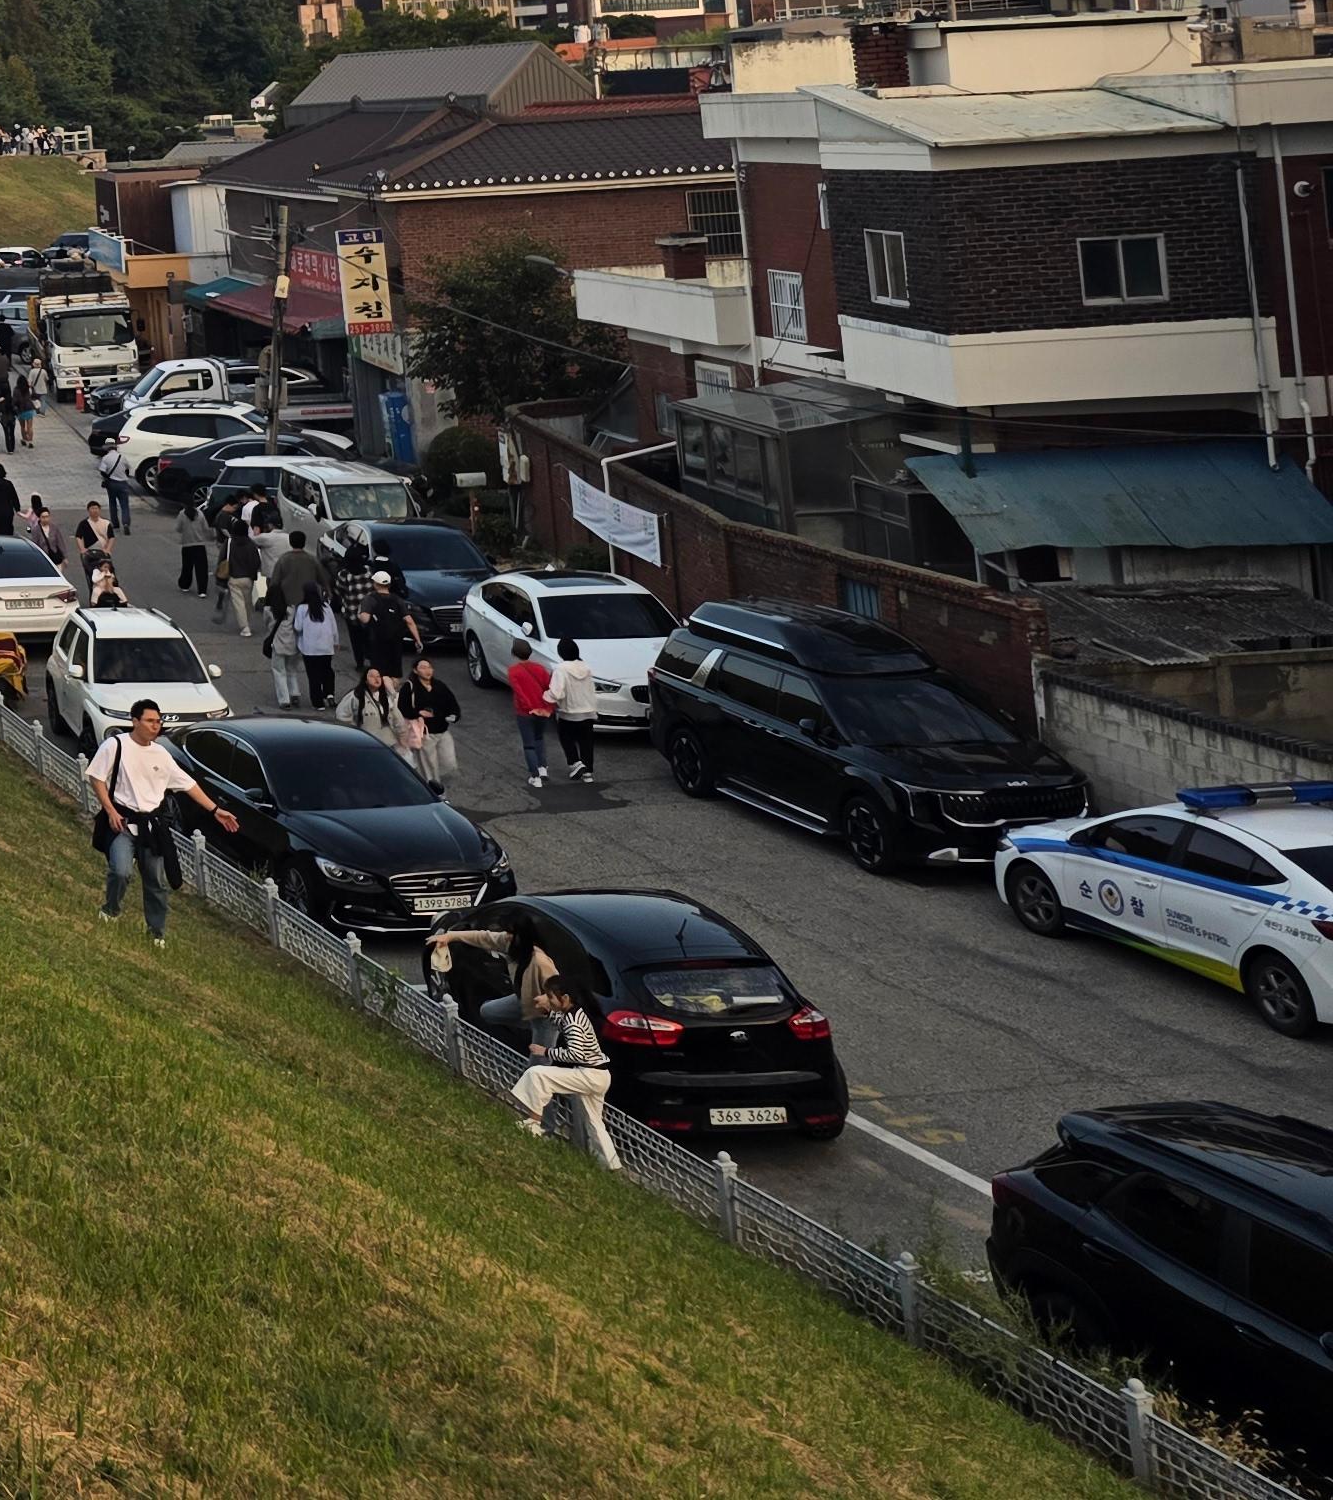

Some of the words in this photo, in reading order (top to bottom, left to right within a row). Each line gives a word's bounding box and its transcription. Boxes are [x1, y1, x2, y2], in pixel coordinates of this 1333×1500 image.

[345, 246, 384, 319] 수지침
[1079, 879, 1093, 900] 순
[445, 897, 468, 907] 5788
[1165, 908, 1193, 924] SUWON
[1202, 929, 1231, 948] PATROL
[716, 1110, 742, 1123] 36오
[747, 1109, 780, 1122] 3626
